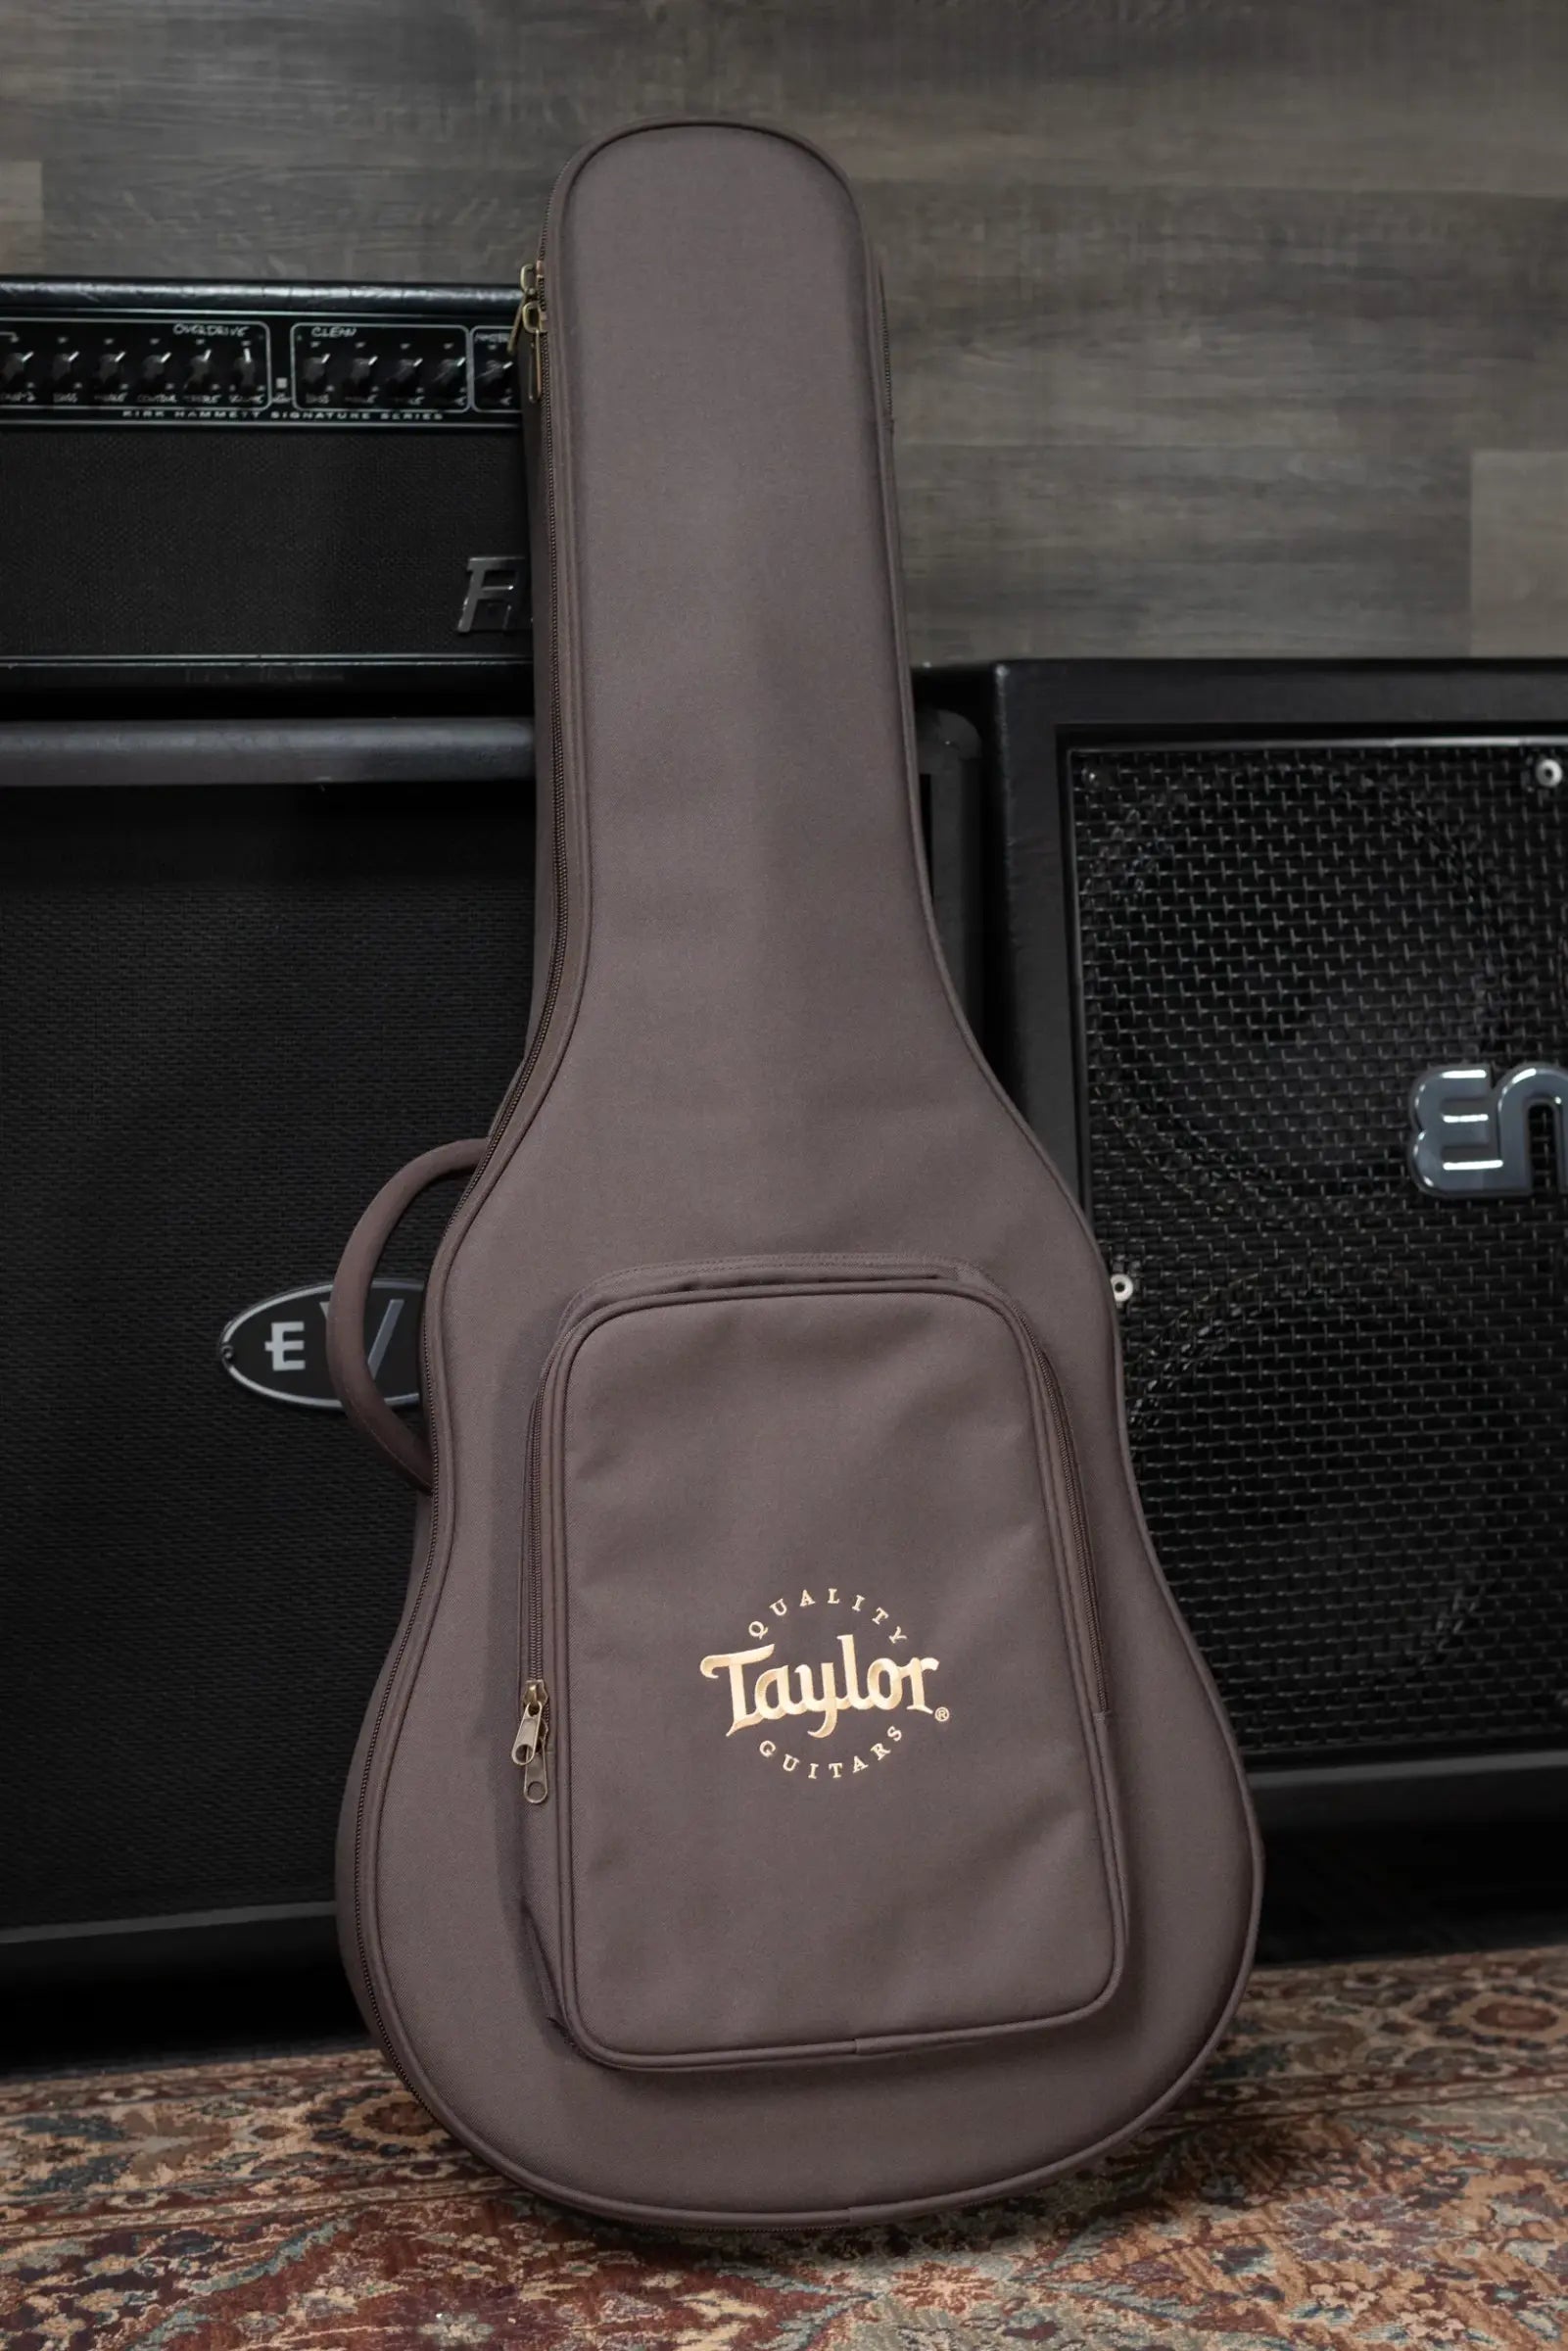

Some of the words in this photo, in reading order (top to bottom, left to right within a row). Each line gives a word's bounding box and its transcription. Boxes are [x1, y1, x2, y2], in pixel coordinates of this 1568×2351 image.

[310, 326, 357, 338] CLEAN
[748, 1588, 907, 1645] QUALITY
[700, 1634, 939, 1739] Taylor
[759, 1725, 902, 1779] GUITARS
